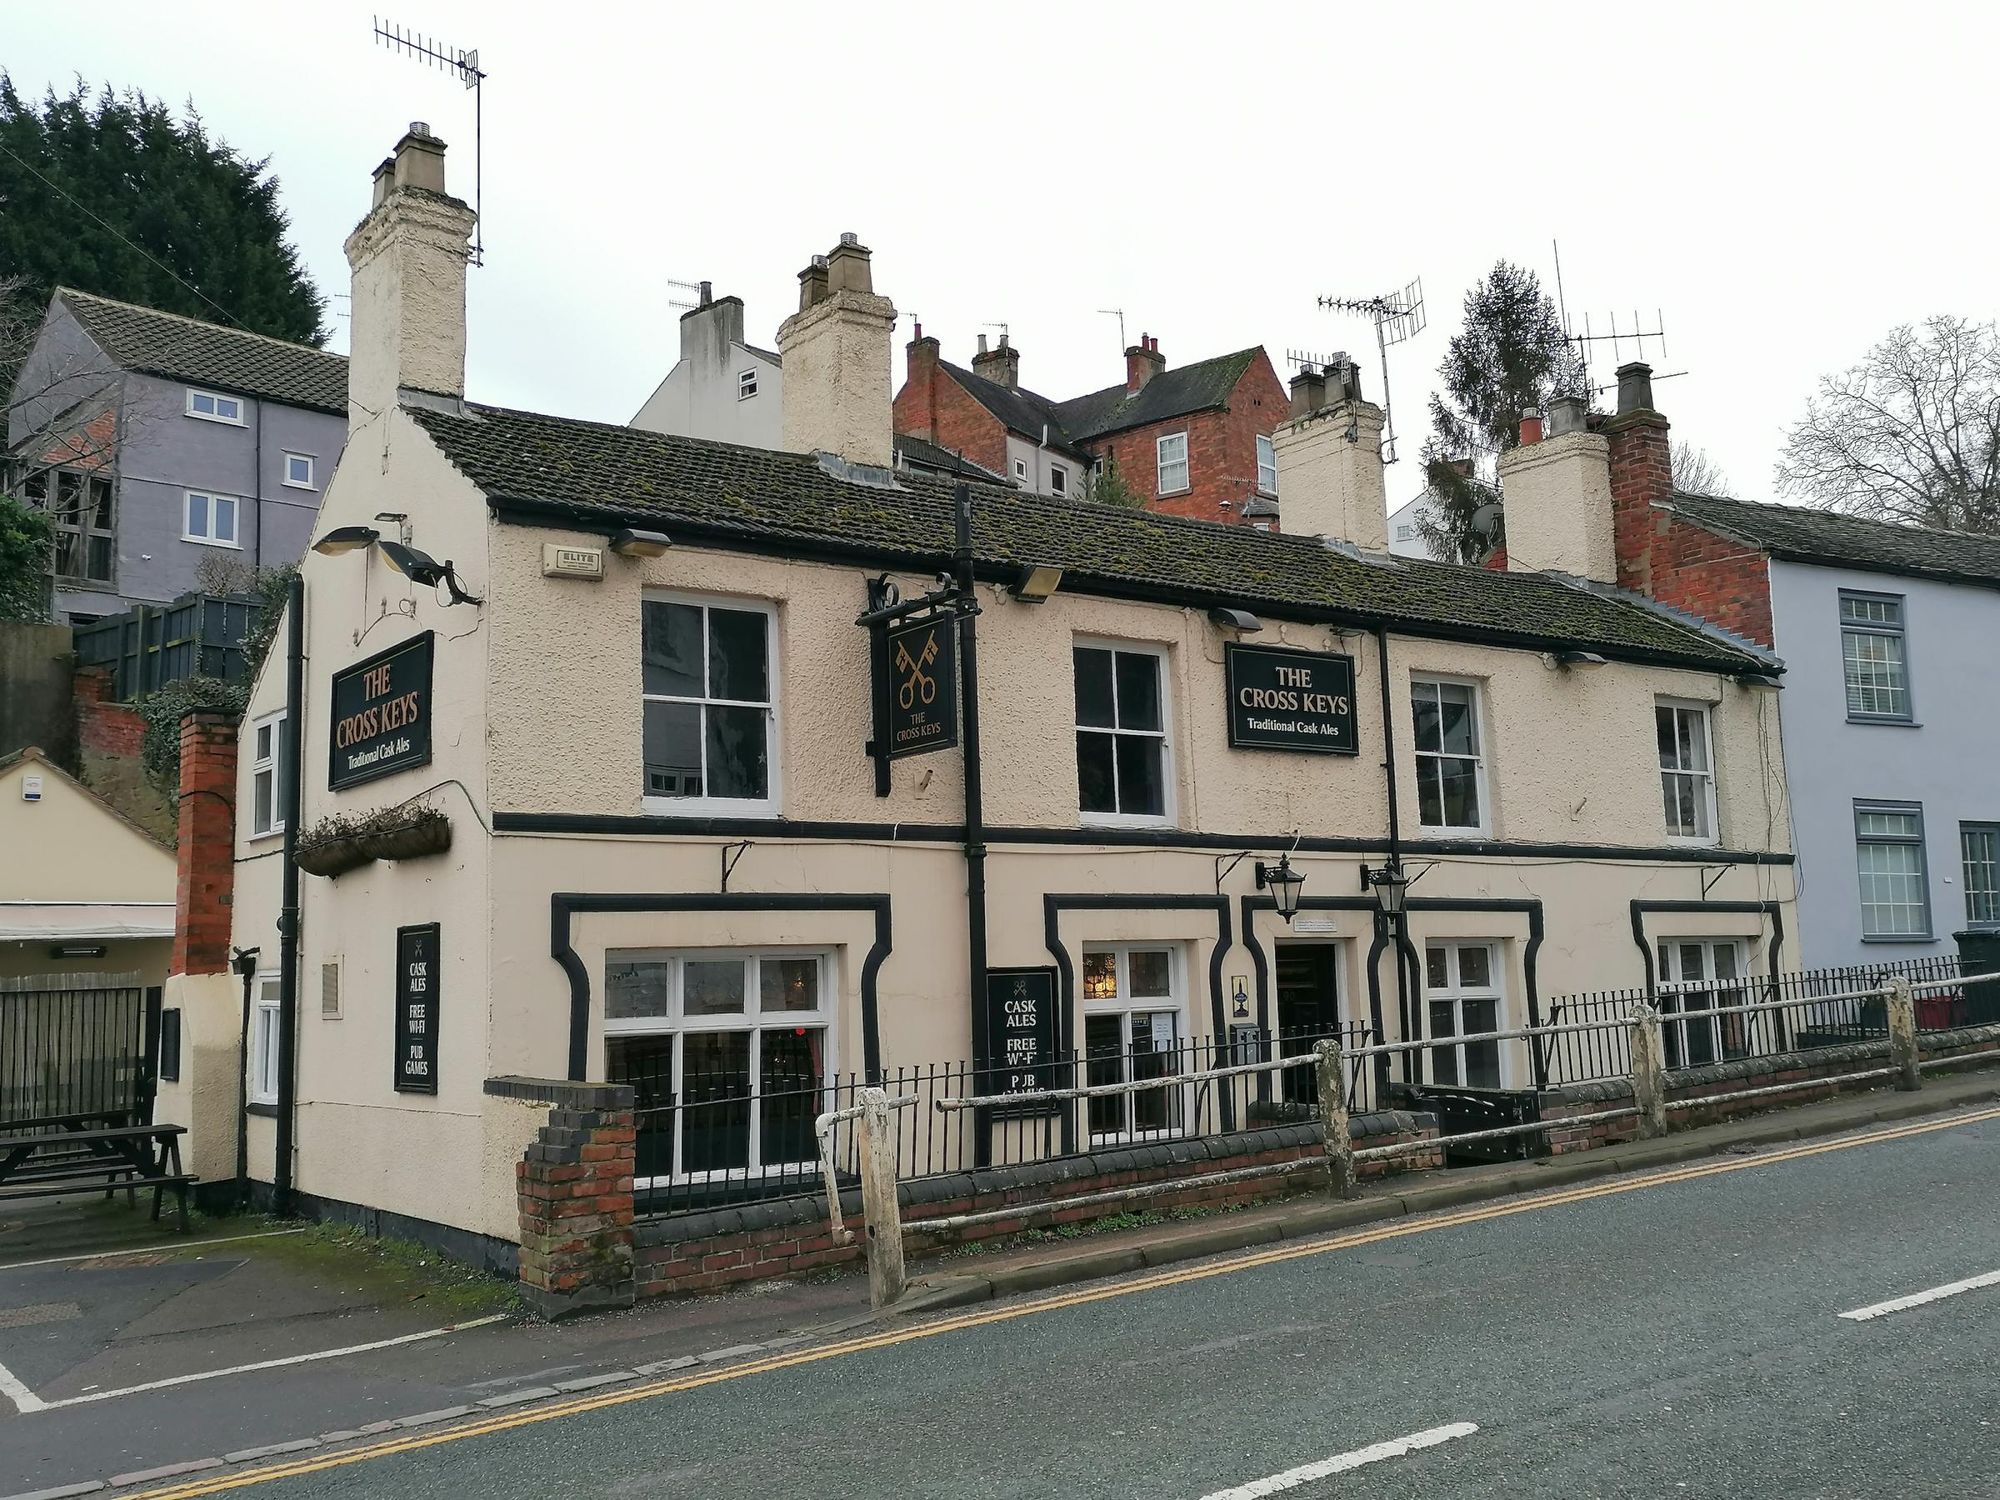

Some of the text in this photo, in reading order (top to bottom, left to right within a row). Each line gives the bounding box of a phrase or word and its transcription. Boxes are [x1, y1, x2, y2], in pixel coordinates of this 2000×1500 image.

[563, 553, 594, 562] ELITE
[363, 664, 391, 701] THE
[1275, 666, 1312, 688] THE
[1240, 687, 1348, 715] CROSS KEYS
[337, 691, 418, 749] CROSS KEYS
[910, 711, 926, 725] THE
[896, 722, 941, 742] CROSS KEYS
[1247, 717, 1339, 736] Traditional Cask Ales
[348, 737, 410, 770] Traditional Cask Ales
[409, 962, 427, 977] CASK
[410, 977, 426, 992] ALES
[409, 1004, 426, 1018] FREE
[1004, 1000, 1037, 1013] CASK
[409, 1020, 425, 1034] WI-FI
[1006, 1014, 1036, 1027] ALES
[410, 1045, 424, 1059] PUB
[1007, 1038, 1037, 1051] FREE
[1006, 1052, 1037, 1066] W-F
[405, 1061, 428, 1076] GAMES
